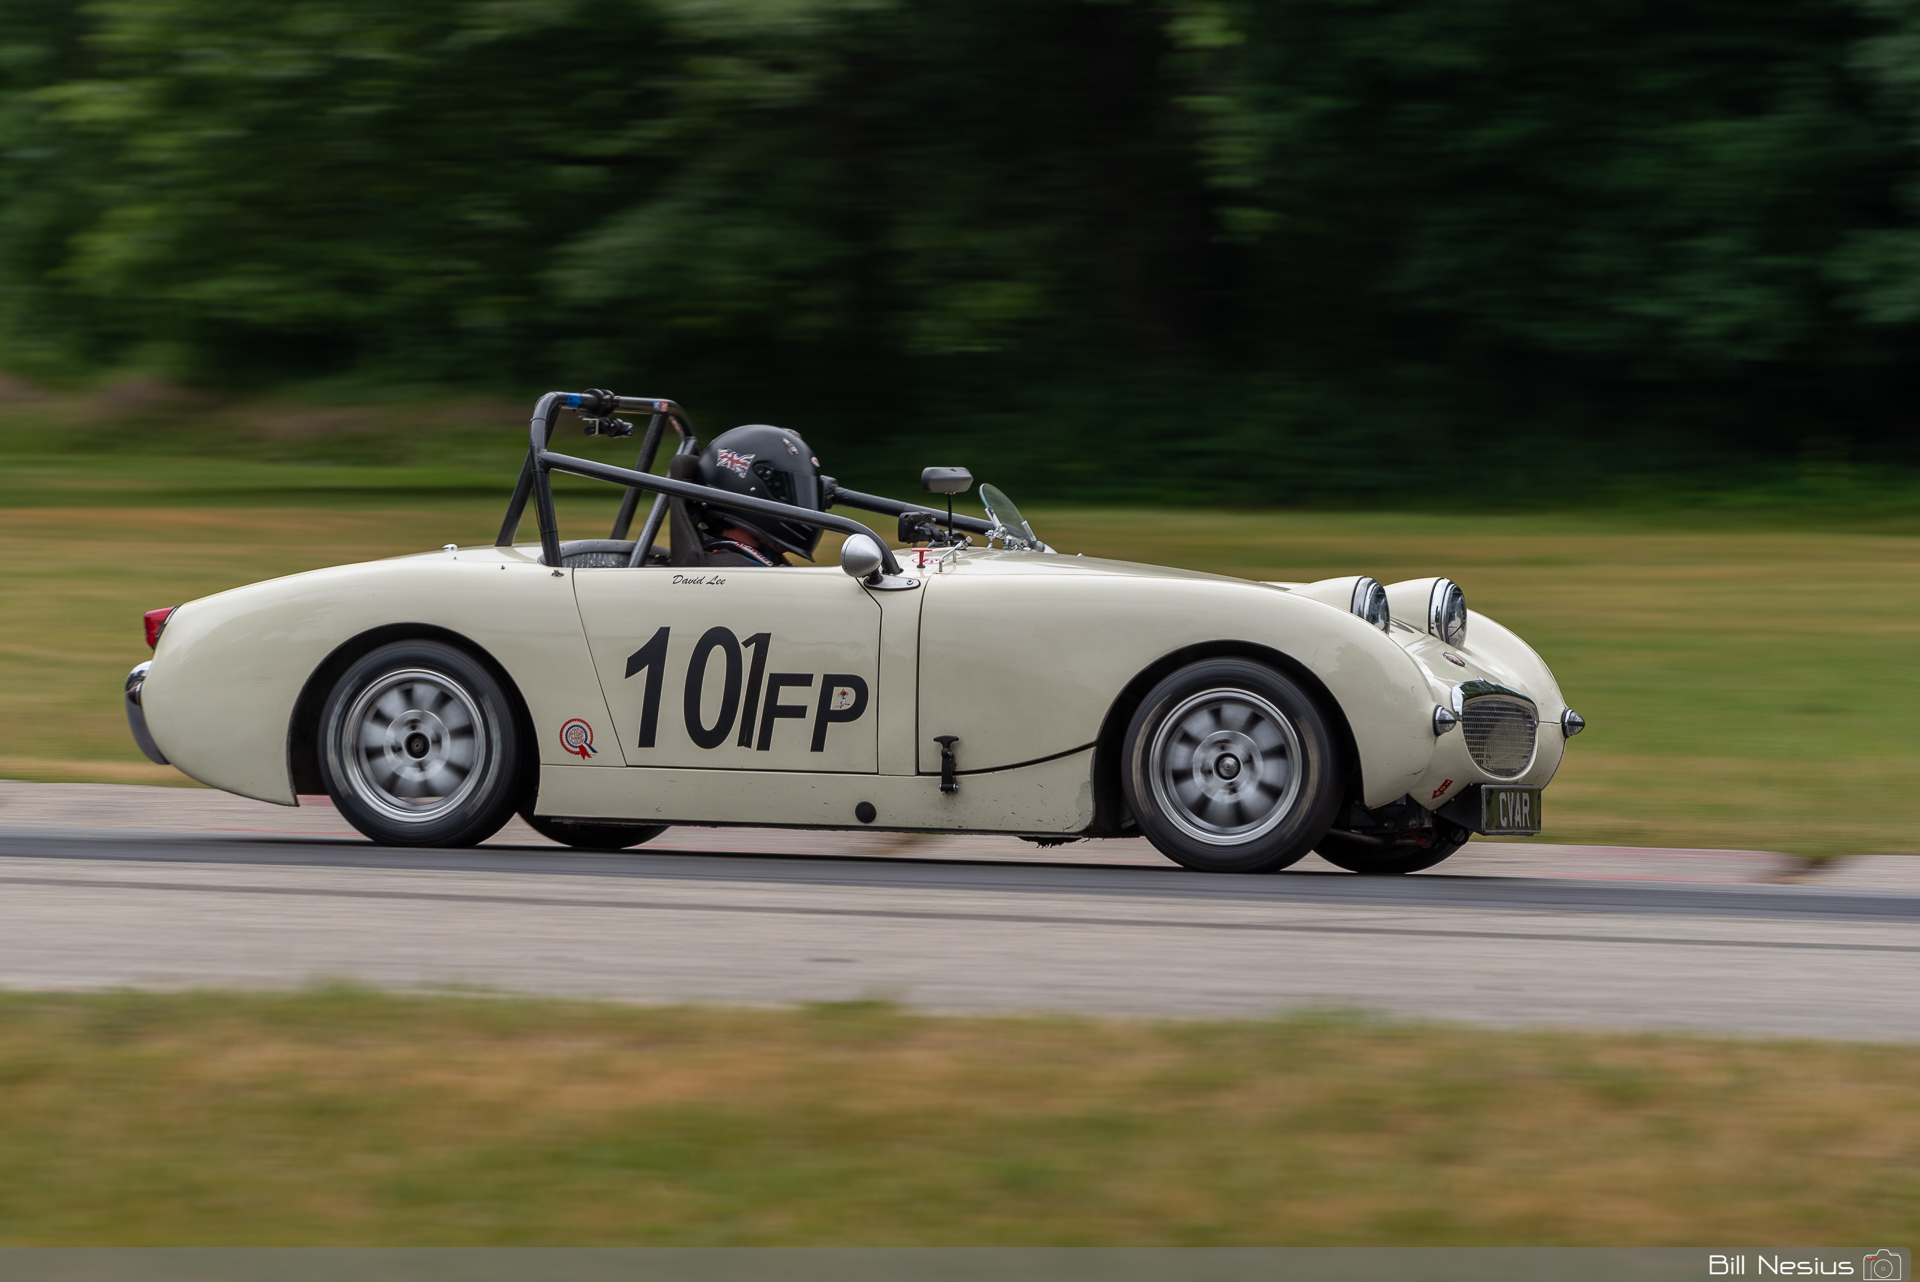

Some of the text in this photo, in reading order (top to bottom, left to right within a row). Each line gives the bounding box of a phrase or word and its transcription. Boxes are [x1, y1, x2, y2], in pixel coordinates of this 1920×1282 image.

[672, 574, 726, 585] David Lee
[1499, 791, 1530, 828] CVAR
